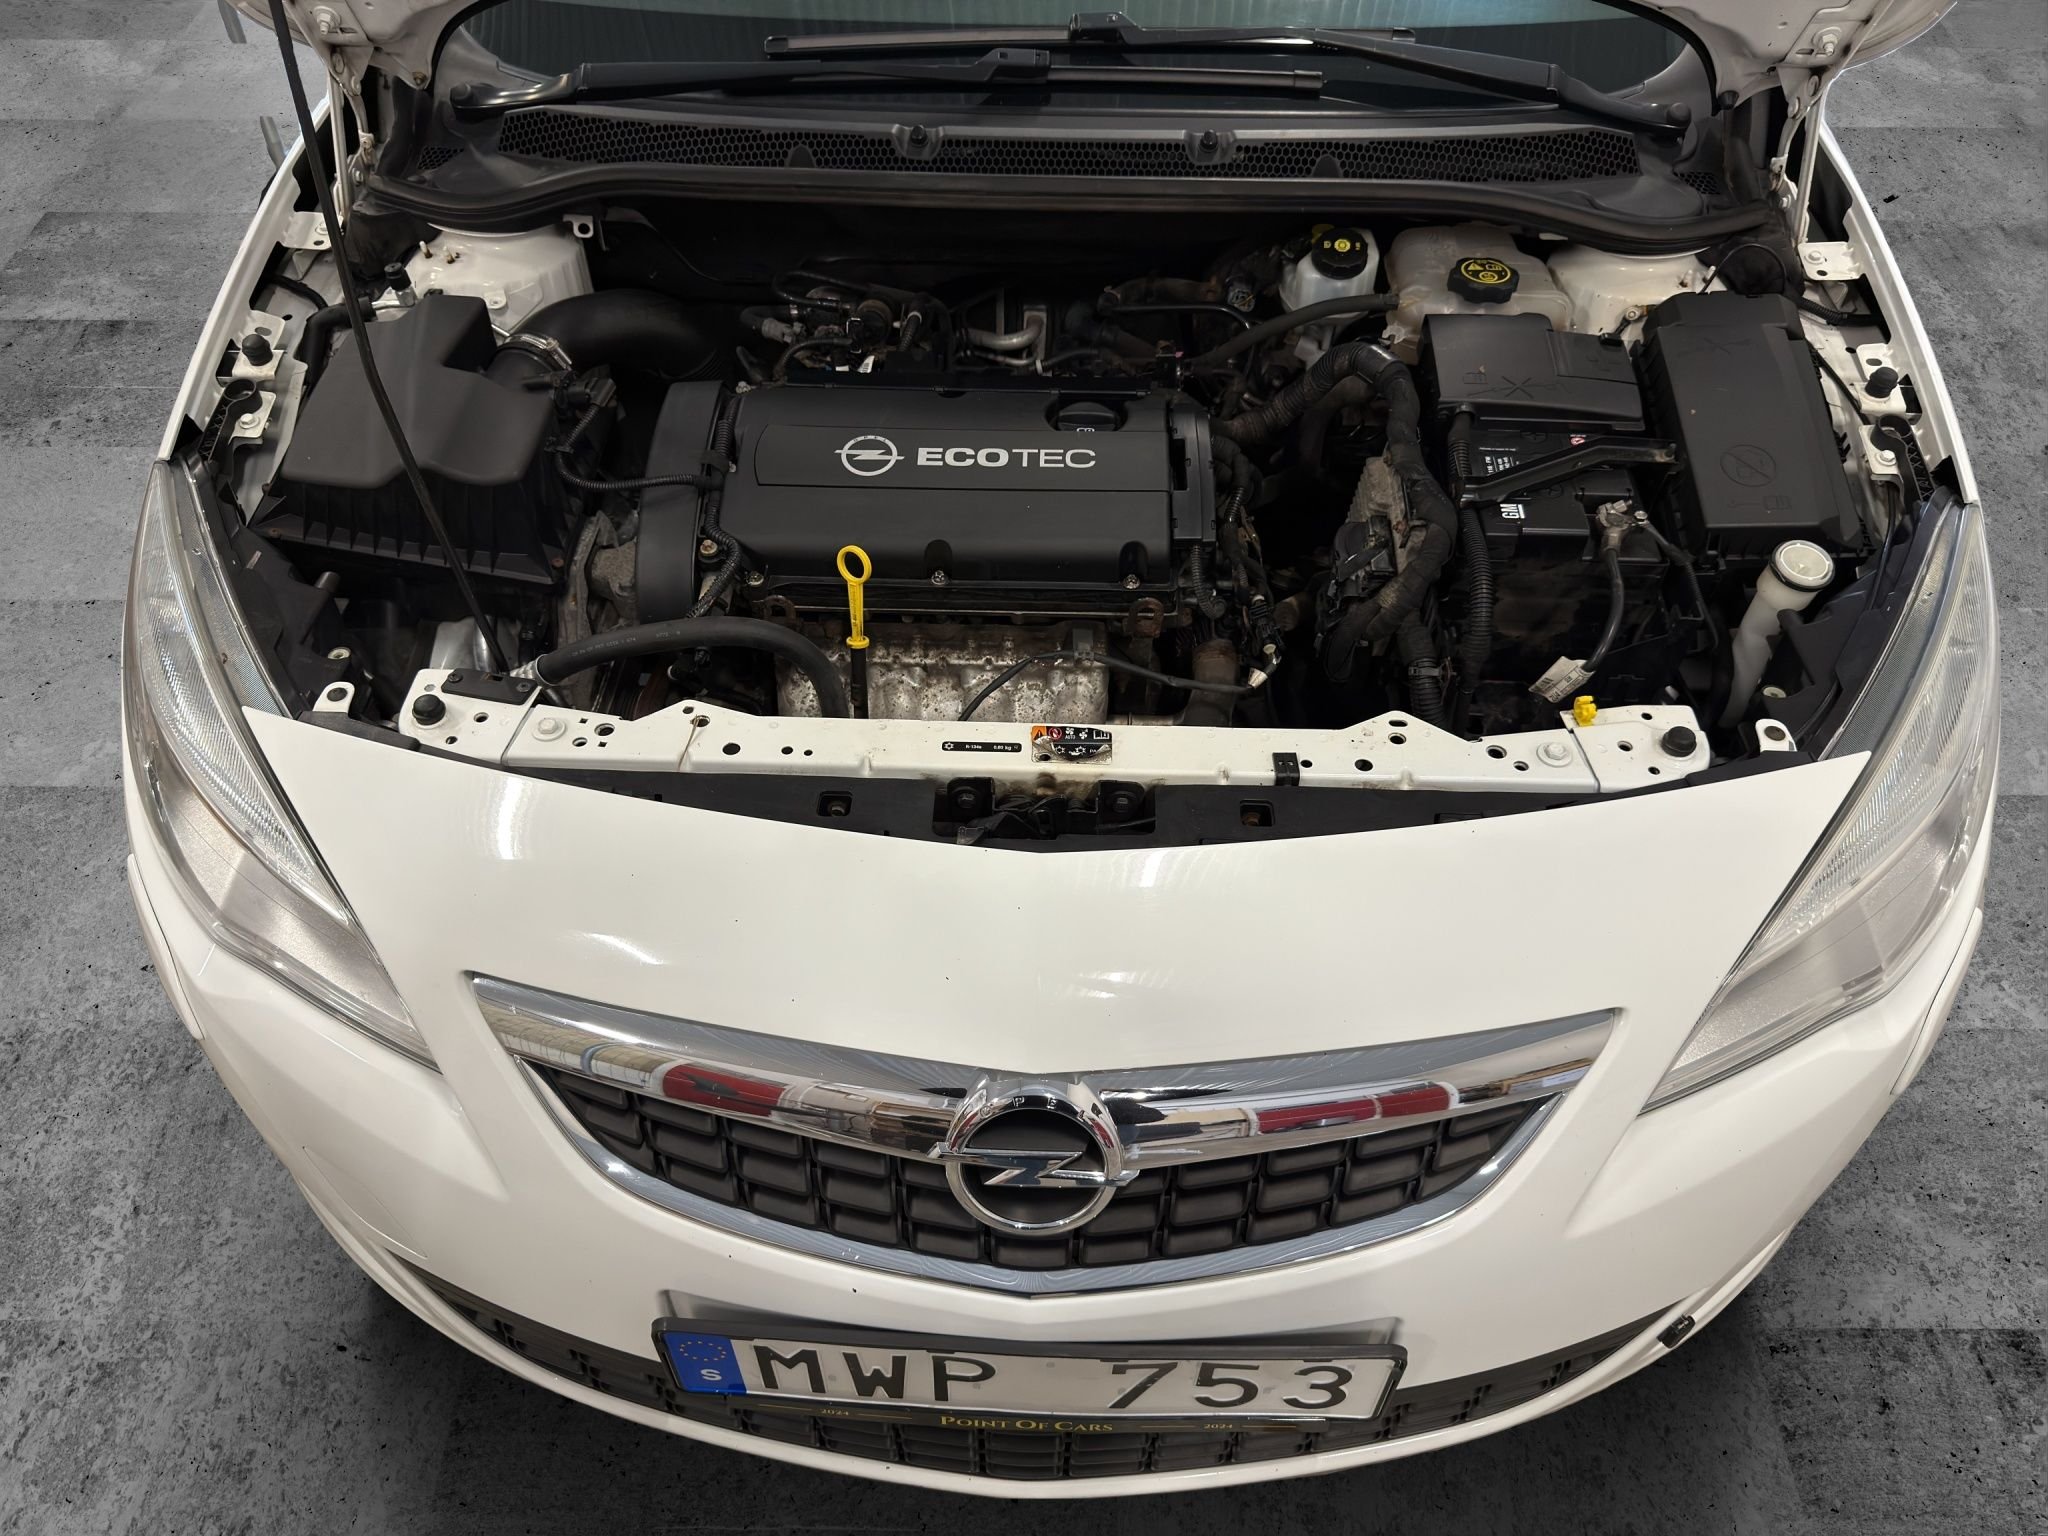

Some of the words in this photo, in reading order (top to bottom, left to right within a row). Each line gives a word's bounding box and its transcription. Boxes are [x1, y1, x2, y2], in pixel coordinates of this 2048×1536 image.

[917, 447, 1096, 469] ECOTEC
[1500, 503, 1520, 519] GM
[701, 1368, 722, 1382] S
[753, 1345, 996, 1402] MWP
[1108, 1361, 1353, 1410] 753
[820, 1408, 850, 1417] 2024
[1203, 1423, 1233, 1431] 2024
